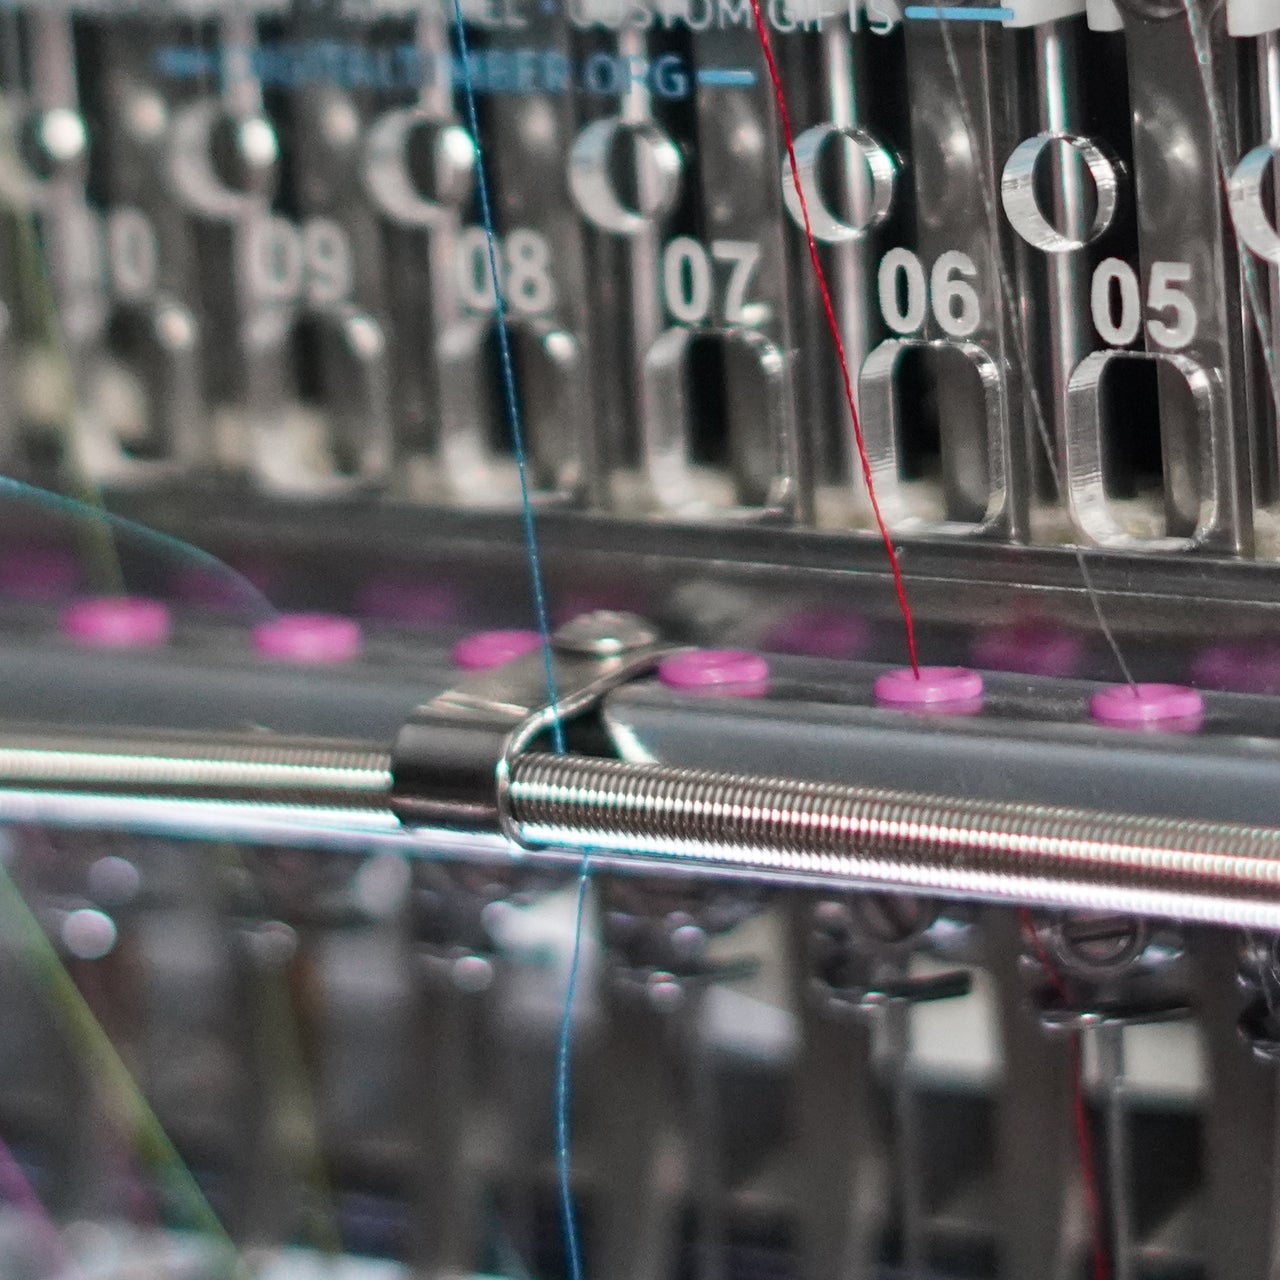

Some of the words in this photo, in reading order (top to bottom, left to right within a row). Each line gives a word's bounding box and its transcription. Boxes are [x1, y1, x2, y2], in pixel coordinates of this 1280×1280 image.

[246, 217, 354, 303] 09
[458, 226, 554, 313] 08
[664, 236, 760, 322] 07
[878, 247, 981, 336] 06
[1091, 257, 1198, 349] 05
